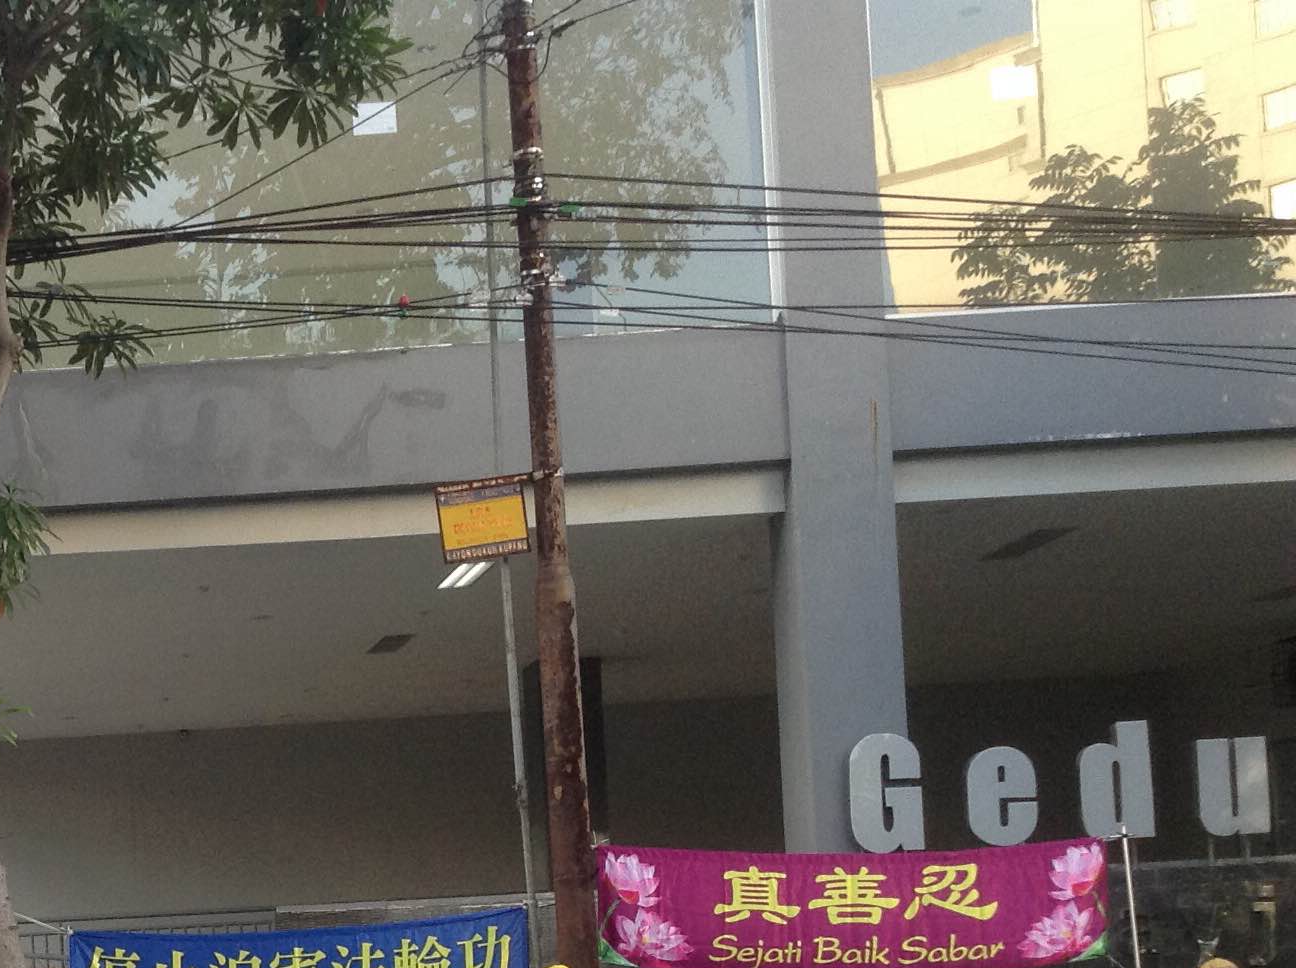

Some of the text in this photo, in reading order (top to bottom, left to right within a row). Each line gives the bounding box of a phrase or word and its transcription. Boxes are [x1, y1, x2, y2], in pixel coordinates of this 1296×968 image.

[713, 863, 999, 925] 真善忍
[813, 934, 891, 965] Baik
[897, 934, 1005, 965] Sabar
